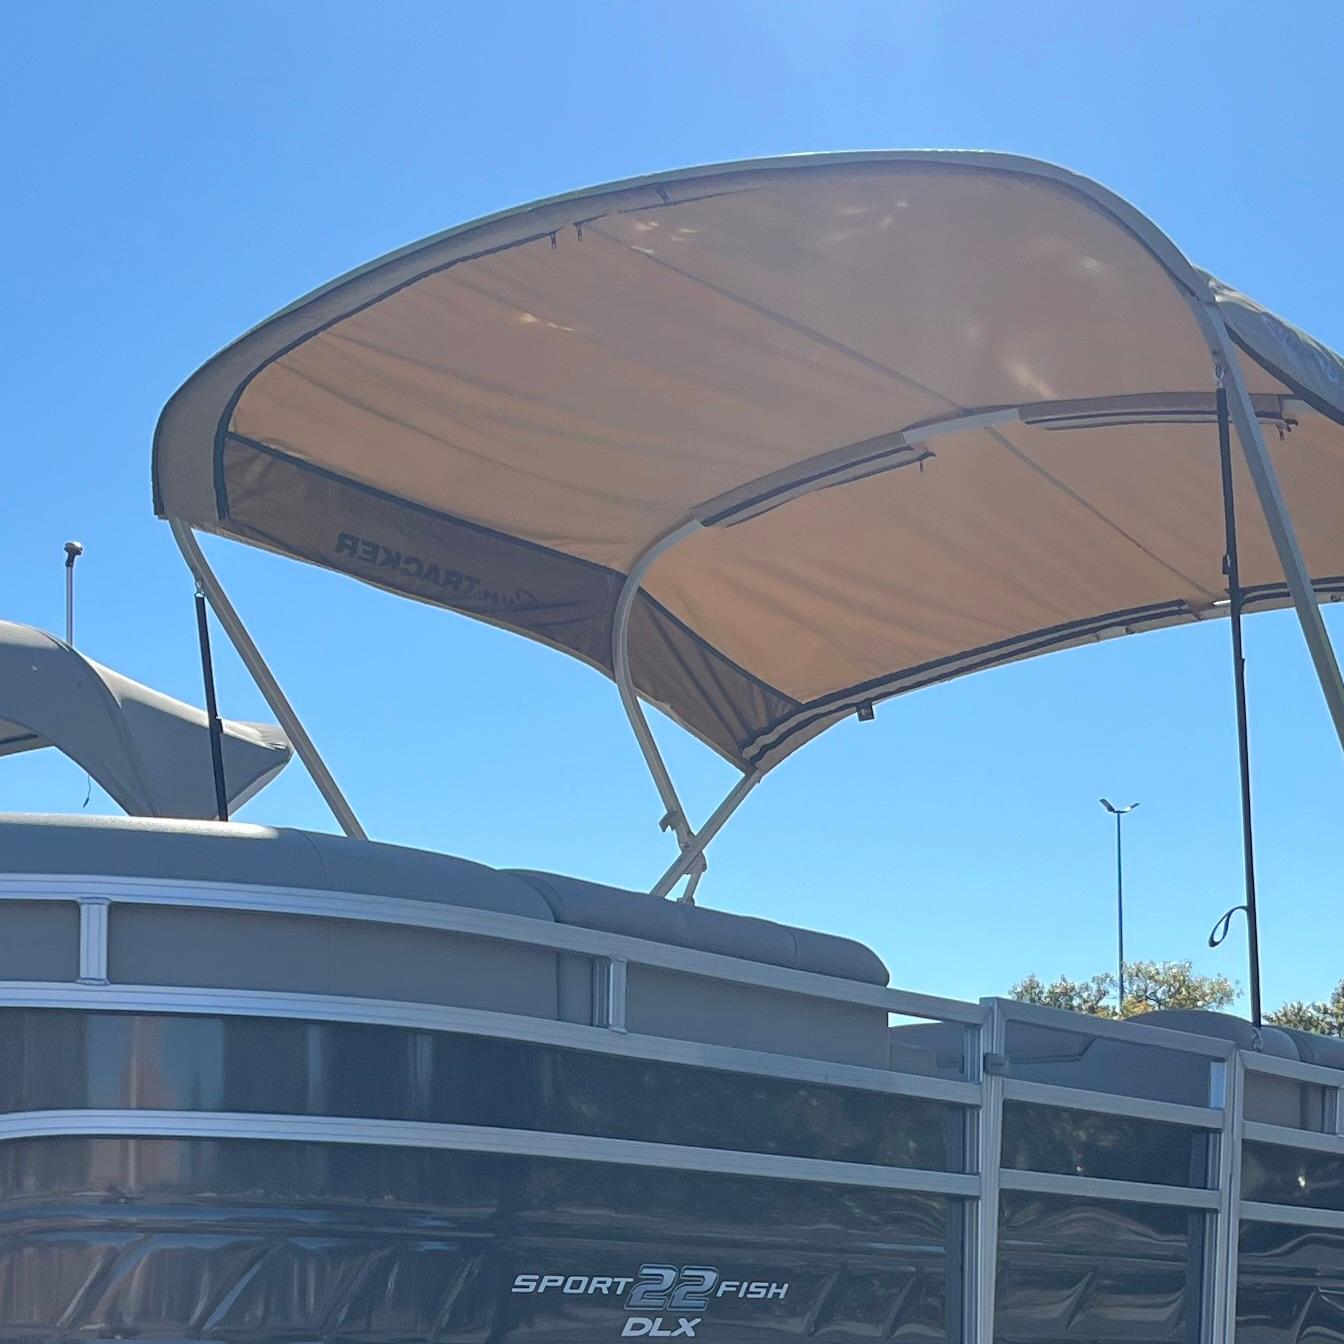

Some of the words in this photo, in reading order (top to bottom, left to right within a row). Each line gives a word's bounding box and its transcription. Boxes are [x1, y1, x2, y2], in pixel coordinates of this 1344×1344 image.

[511, 1273, 634, 1296] SPORT
[623, 1263, 719, 1312] 22
[716, 1281, 789, 1300] FISH
[621, 1316, 702, 1337] DLX
